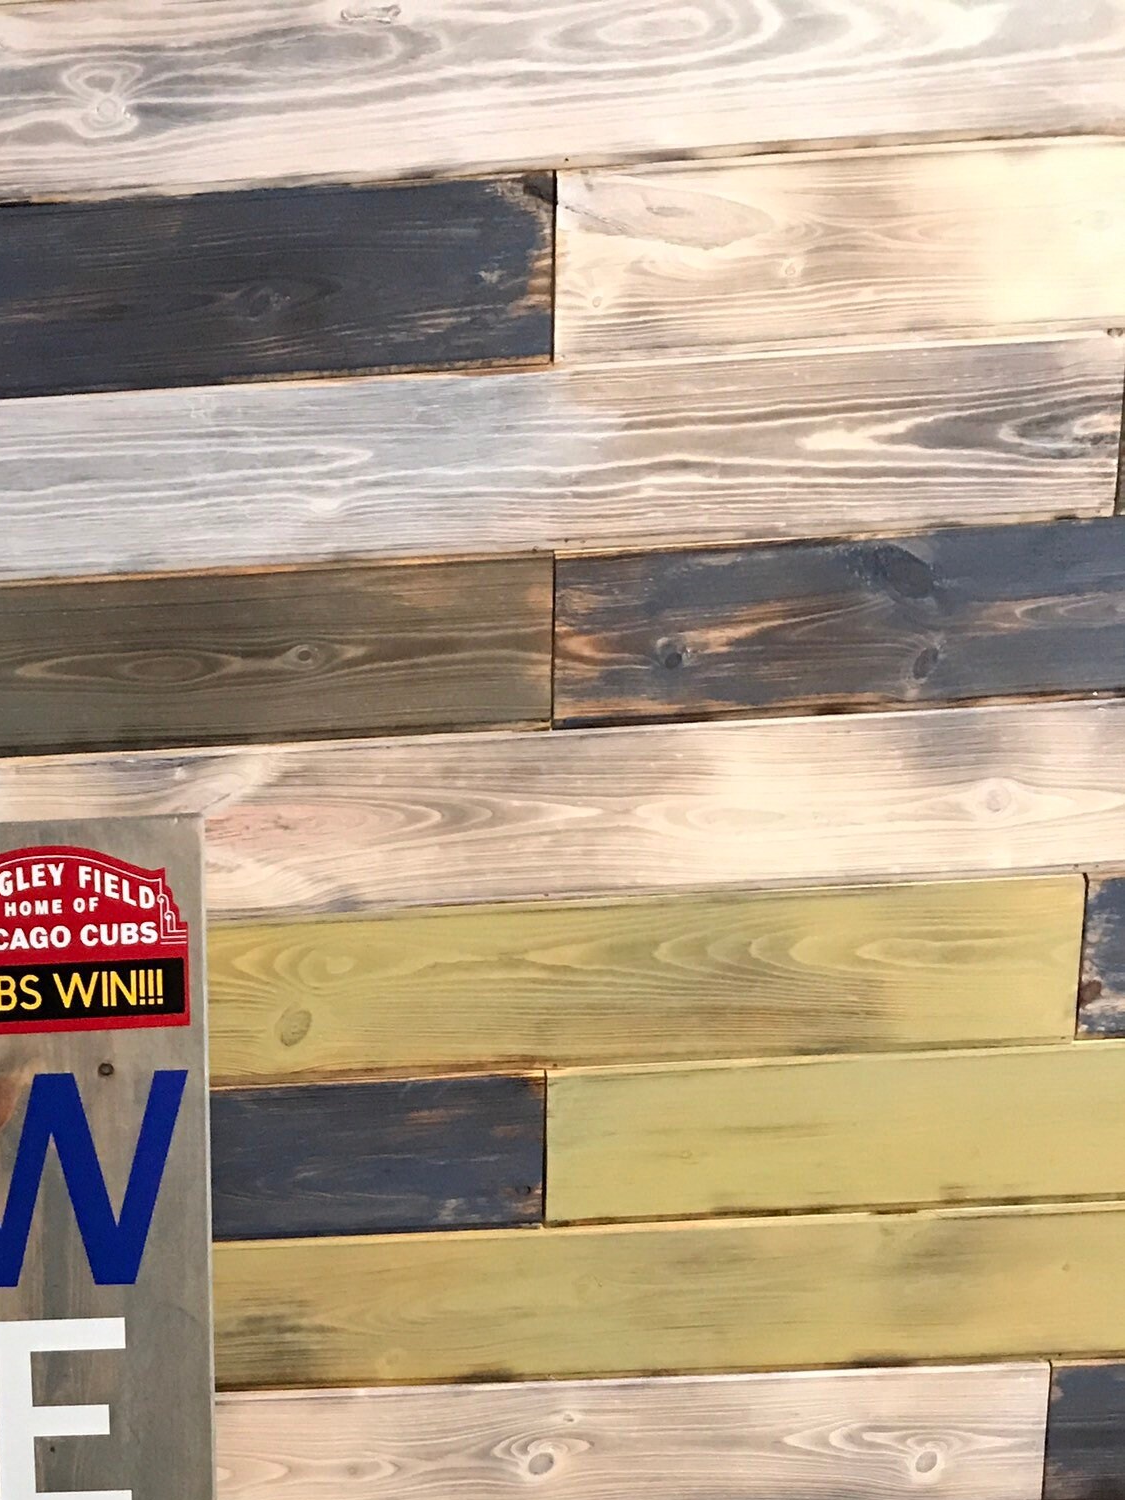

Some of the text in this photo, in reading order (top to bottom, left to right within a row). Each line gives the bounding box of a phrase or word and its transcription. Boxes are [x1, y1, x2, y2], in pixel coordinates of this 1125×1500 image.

[78, 865, 155, 910] FIELD
[4, 896, 99, 917] HOME OF
[79, 921, 159, 947] CUBS
[52, 968, 164, 1009] WIN!!!
